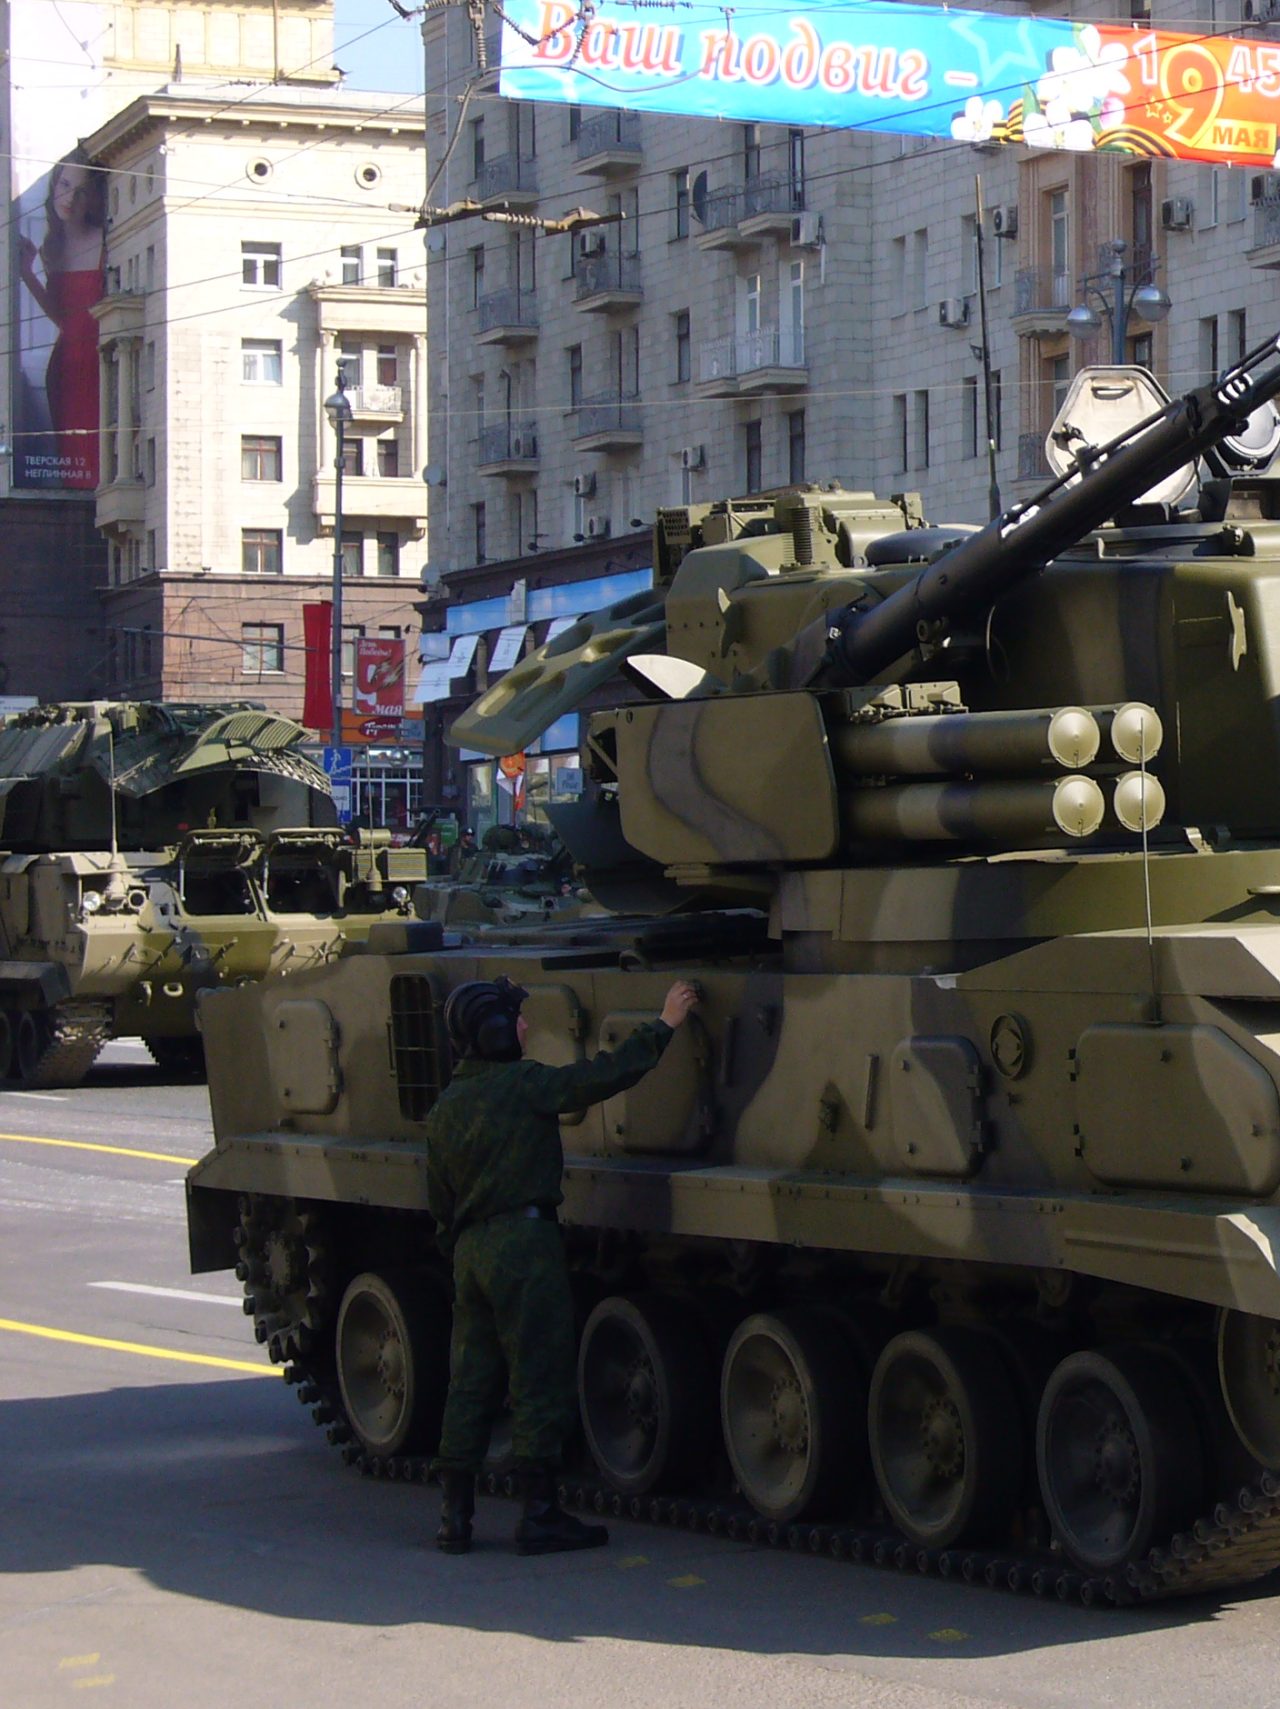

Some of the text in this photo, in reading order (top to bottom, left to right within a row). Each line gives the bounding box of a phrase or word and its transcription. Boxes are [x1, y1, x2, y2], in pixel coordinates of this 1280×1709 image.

[532, 1, 679, 72] Ваш
[702, 20, 925, 96] подвиг
[1212, 126, 1270, 148] МАЯ
[25, 455, 71, 466] ТВЕРСКАЯ
[25, 468, 83, 479] НЕГЛИННАЯ
[373, 704, 402, 716] мая
